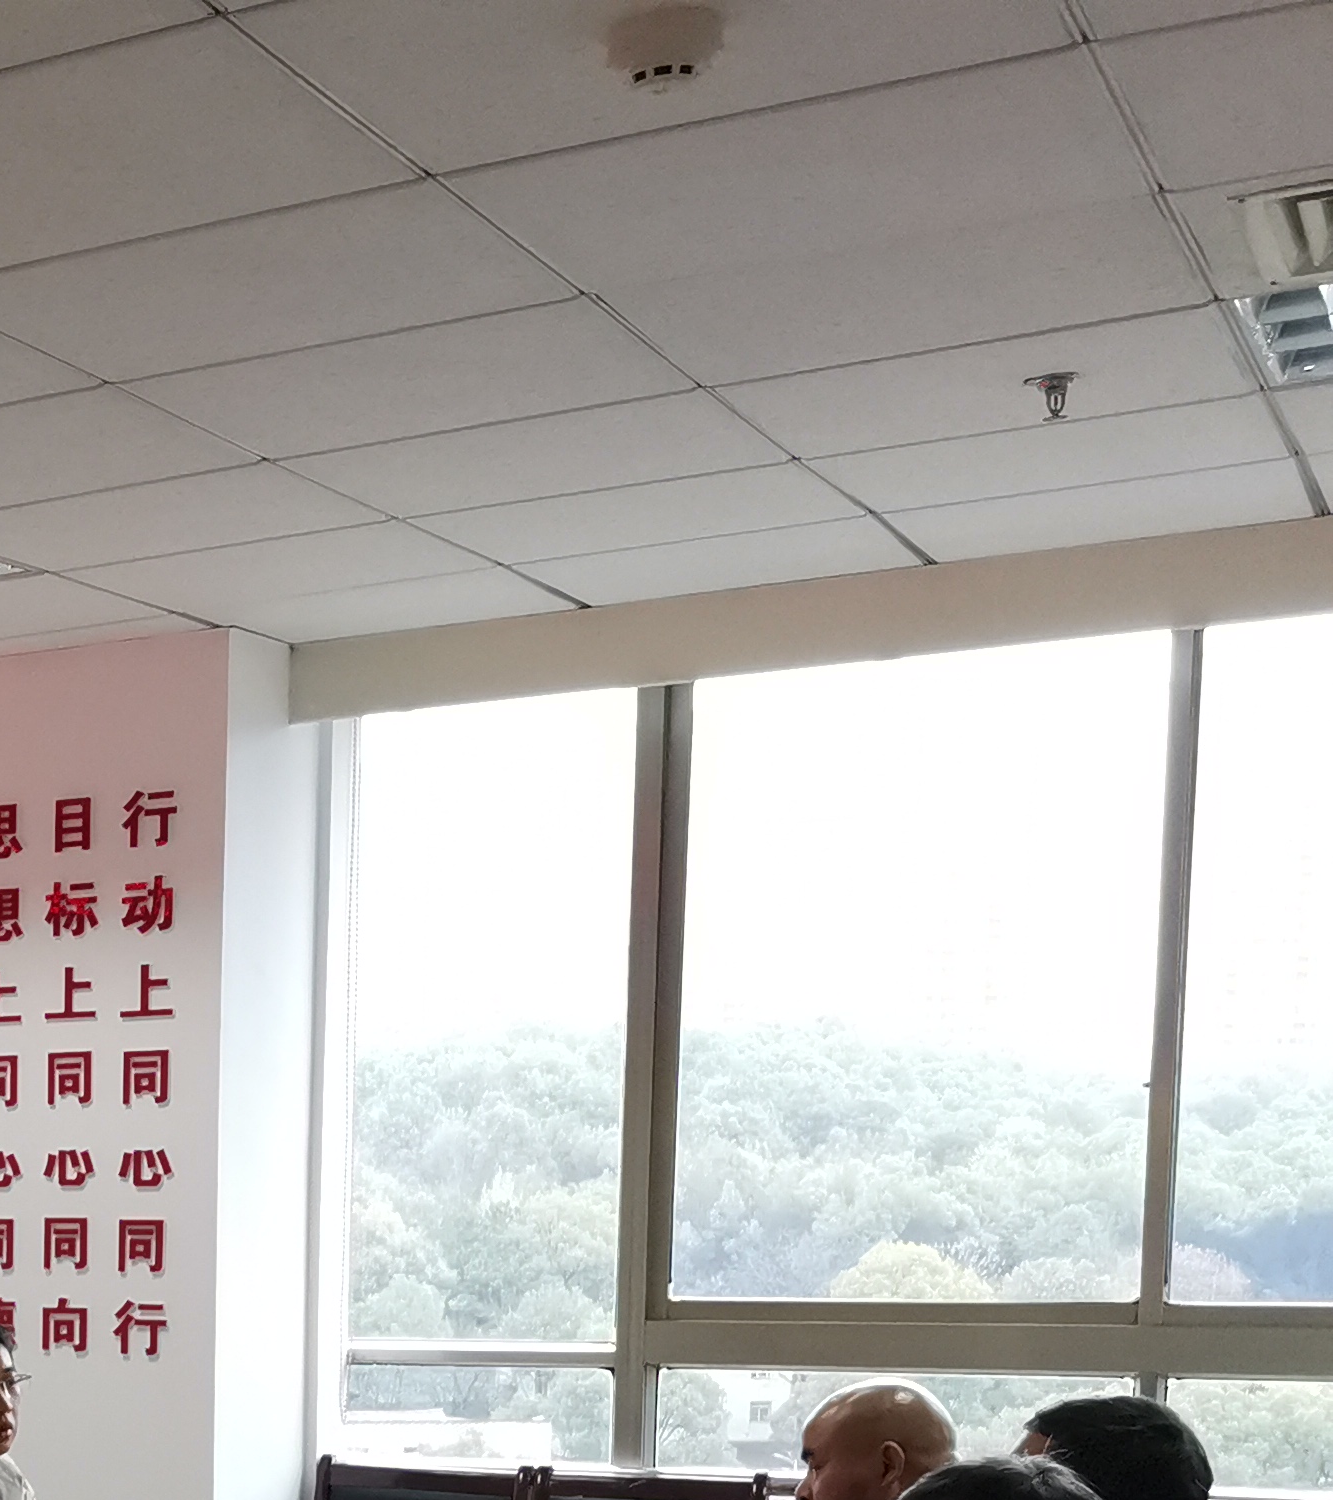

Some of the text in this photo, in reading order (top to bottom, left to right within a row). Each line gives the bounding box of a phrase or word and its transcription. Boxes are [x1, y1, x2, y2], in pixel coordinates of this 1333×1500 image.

[41, 798, 99, 1353] 目标上同心同向
[114, 790, 178, 1356] 行动上同心同行
